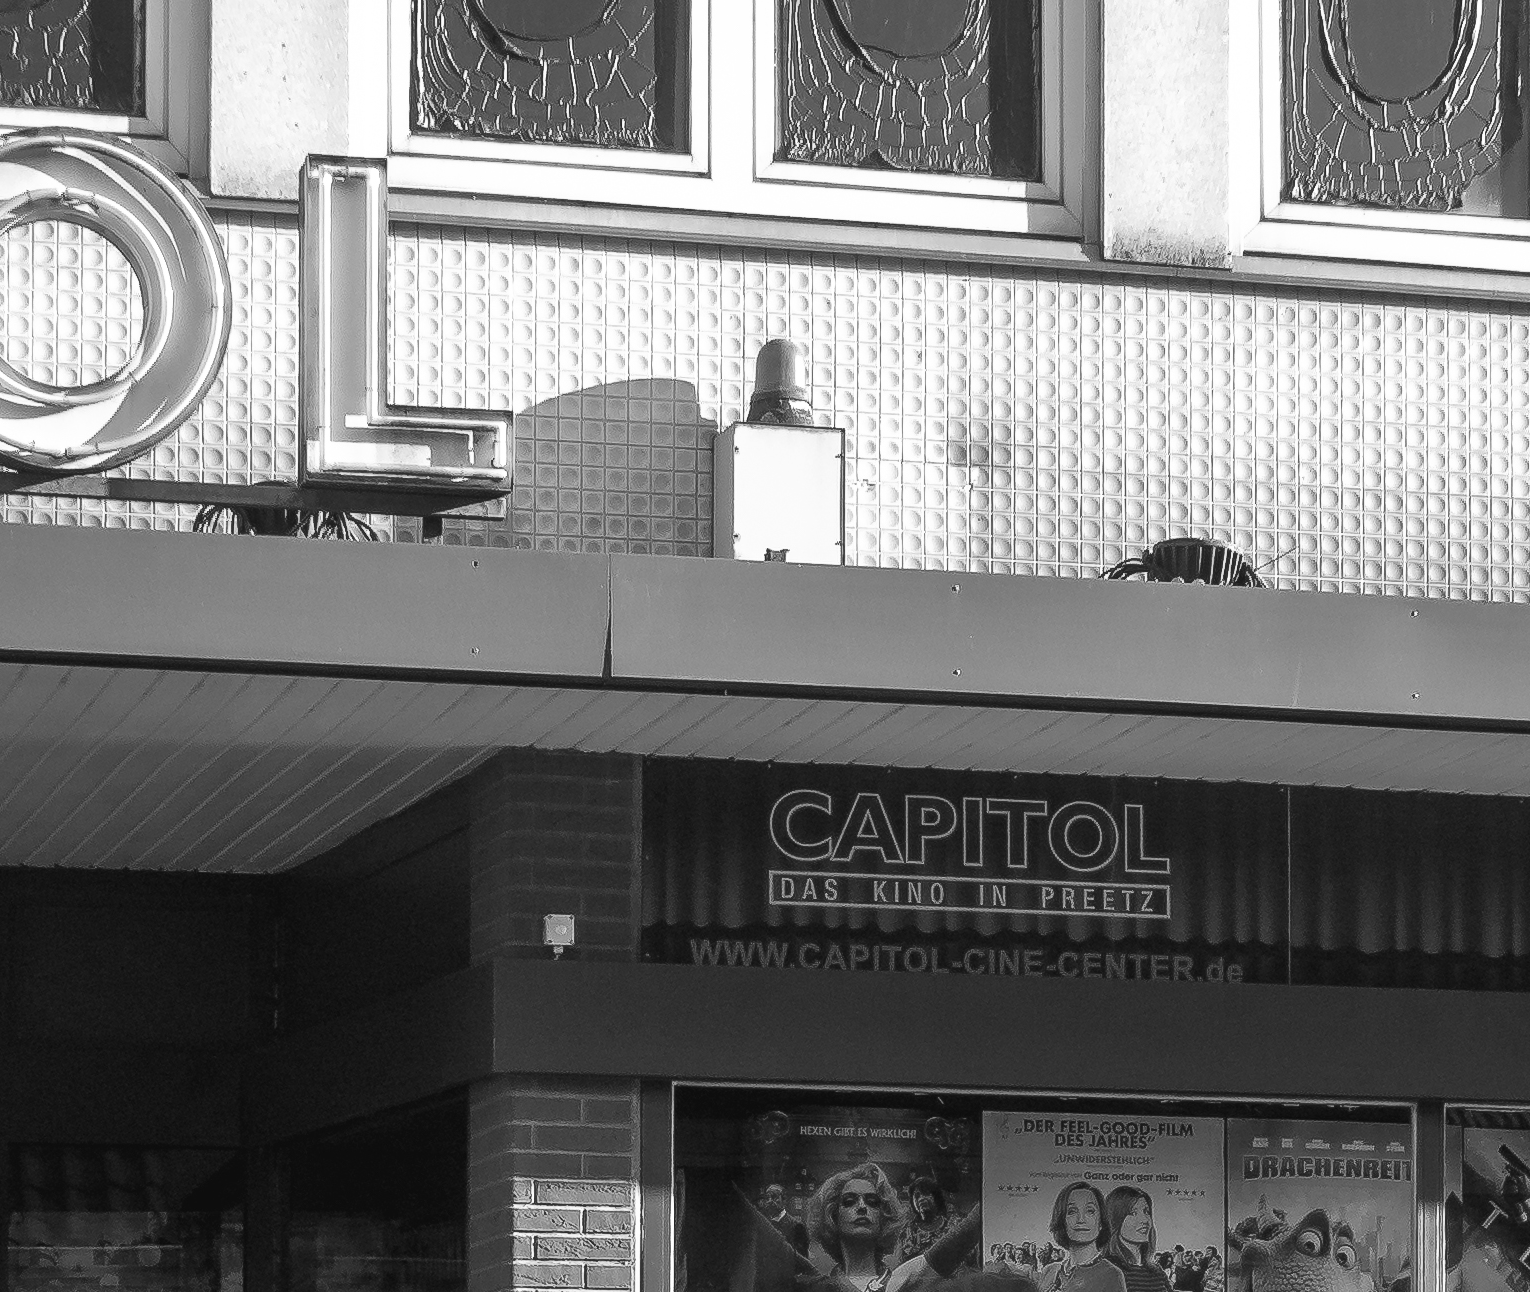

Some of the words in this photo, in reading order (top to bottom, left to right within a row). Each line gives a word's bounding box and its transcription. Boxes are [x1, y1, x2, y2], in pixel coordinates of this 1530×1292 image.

[769, 789, 1170, 874] CAPITOL
[780, 877, 839, 902] DAS
[872, 880, 946, 905] KINO
[978, 883, 1007, 908] IN
[1041, 886, 1155, 913] PREETZ
[690, 937, 1245, 985] WWW.CAPITOL-CINE-CENTER.de
[799, 1125, 832, 1136] HEXEN
[833, 1126, 856, 1137] GIBT
[857, 1126, 868, 1137] ES
[1059, 1119, 1194, 1137] FEEL-GOOD-FILM
[1054, 1132, 1084, 1148] DES
[1083, 1171, 1110, 1181] Ganz
[1112, 1172, 1136, 1182] oder
[1137, 1173, 1154, 1184] gar
